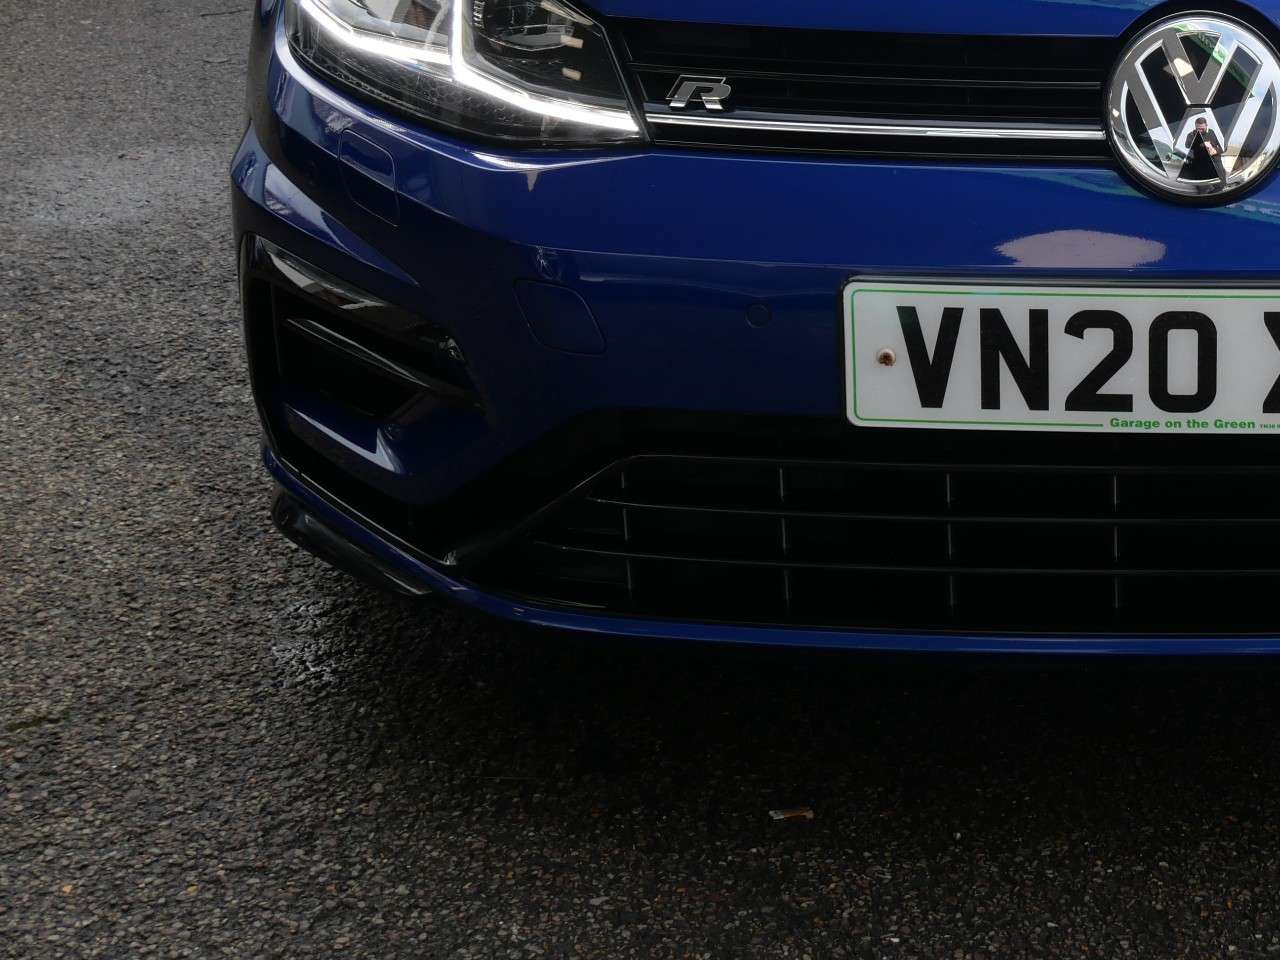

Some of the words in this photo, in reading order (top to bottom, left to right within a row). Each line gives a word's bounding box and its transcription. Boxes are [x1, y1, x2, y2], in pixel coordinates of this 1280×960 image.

[896, 305, 1218, 414] VN20
[1110, 417, 1160, 430] Garage
[1165, 420, 1182, 429] on
[1186, 418, 1209, 429] the
[1214, 418, 1256, 430] Green
